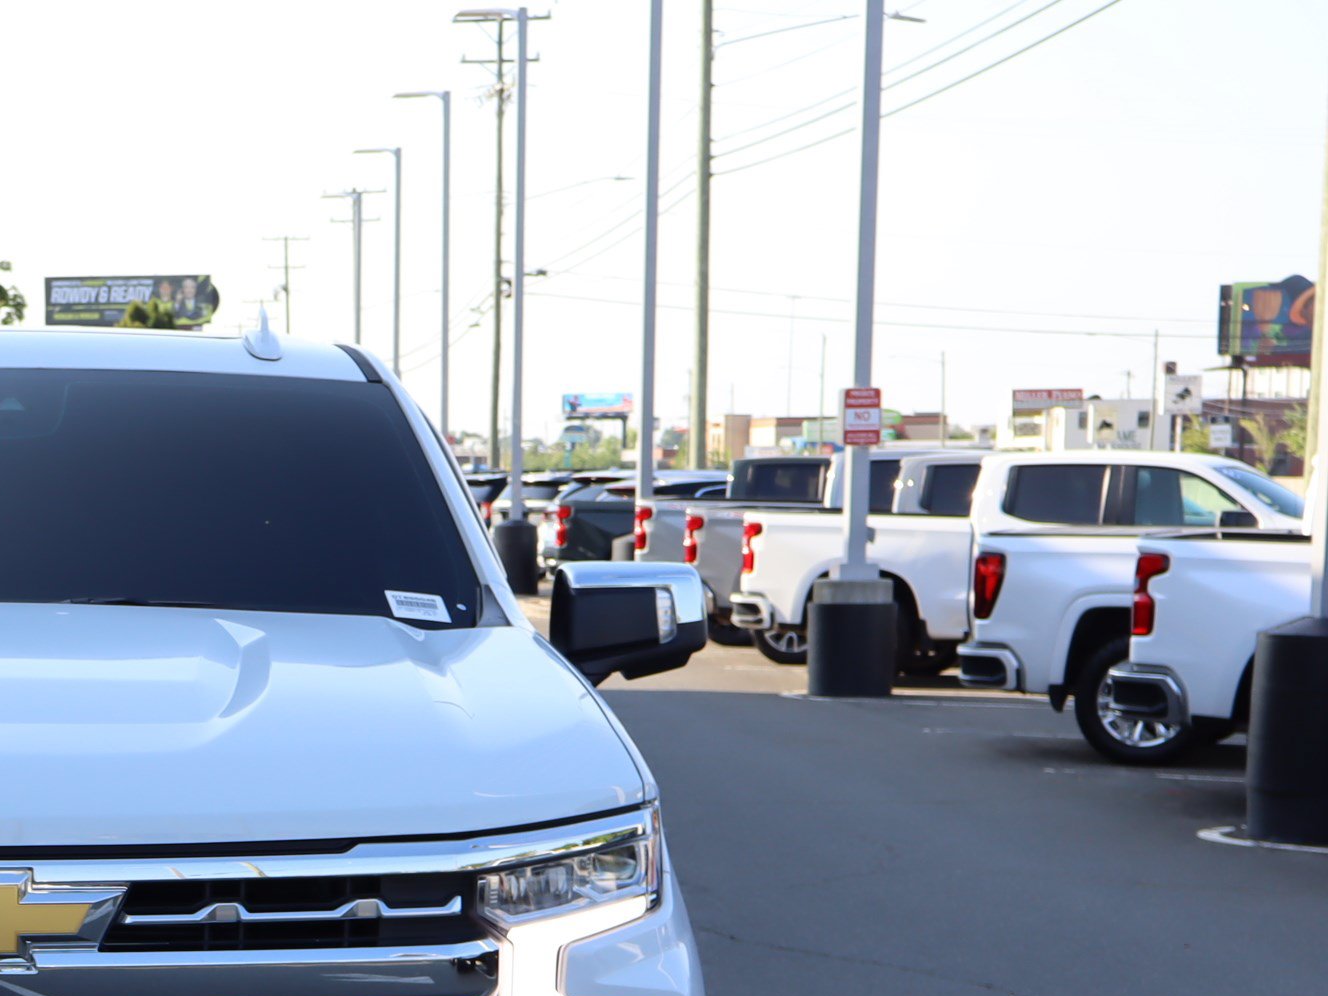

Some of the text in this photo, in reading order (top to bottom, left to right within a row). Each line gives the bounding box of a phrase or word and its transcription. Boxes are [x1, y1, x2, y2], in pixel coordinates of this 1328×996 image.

[51, 287, 98, 303] ROWDY
[110, 285, 153, 303] READY
[854, 410, 871, 421] NO
